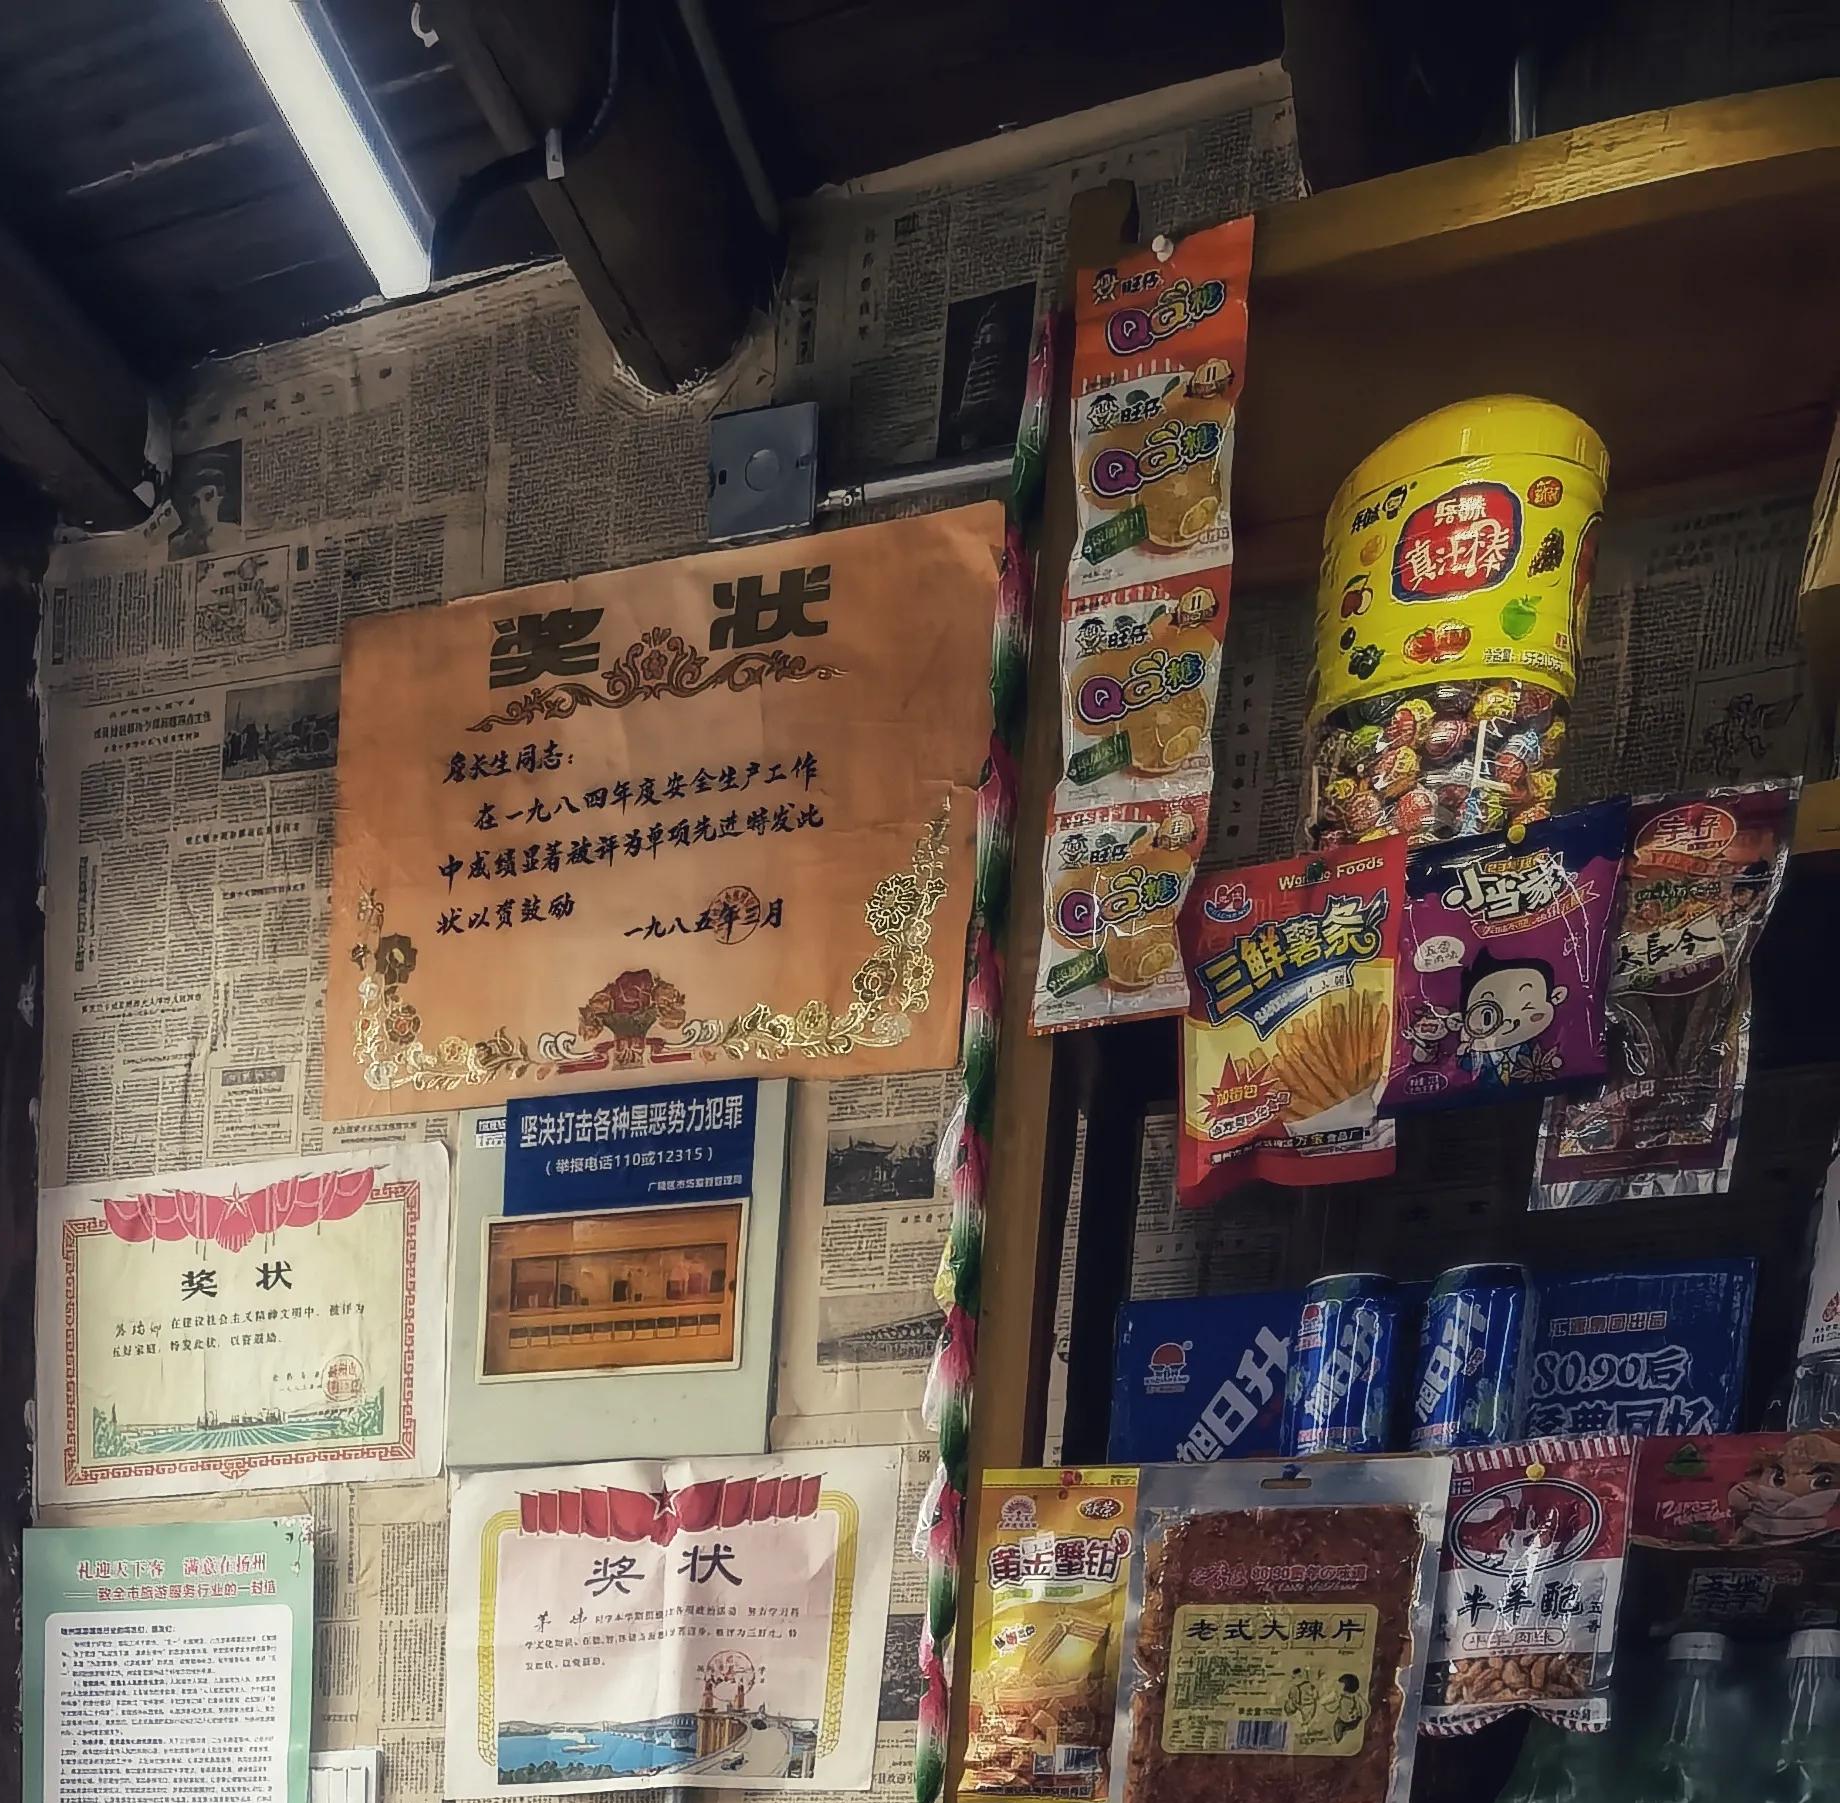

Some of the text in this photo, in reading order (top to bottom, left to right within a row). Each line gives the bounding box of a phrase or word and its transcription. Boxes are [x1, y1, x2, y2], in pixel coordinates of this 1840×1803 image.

[1105, 624, 1150, 650] 旺仔
[1078, 650, 1206, 725] QQ糖
[1089, 841, 1131, 865] 旺仔
[1336, 856, 1385, 879] Foods
[1204, 895, 1387, 1005] 三鲜薯条
[520, 1094, 744, 1149] 坚决打击各种黑恶势力犯罪
[180, 1259, 293, 1301] 奖状
[584, 1543, 743, 1597] 奖状
[1185, 1618, 1365, 1642] 老式大辣片
